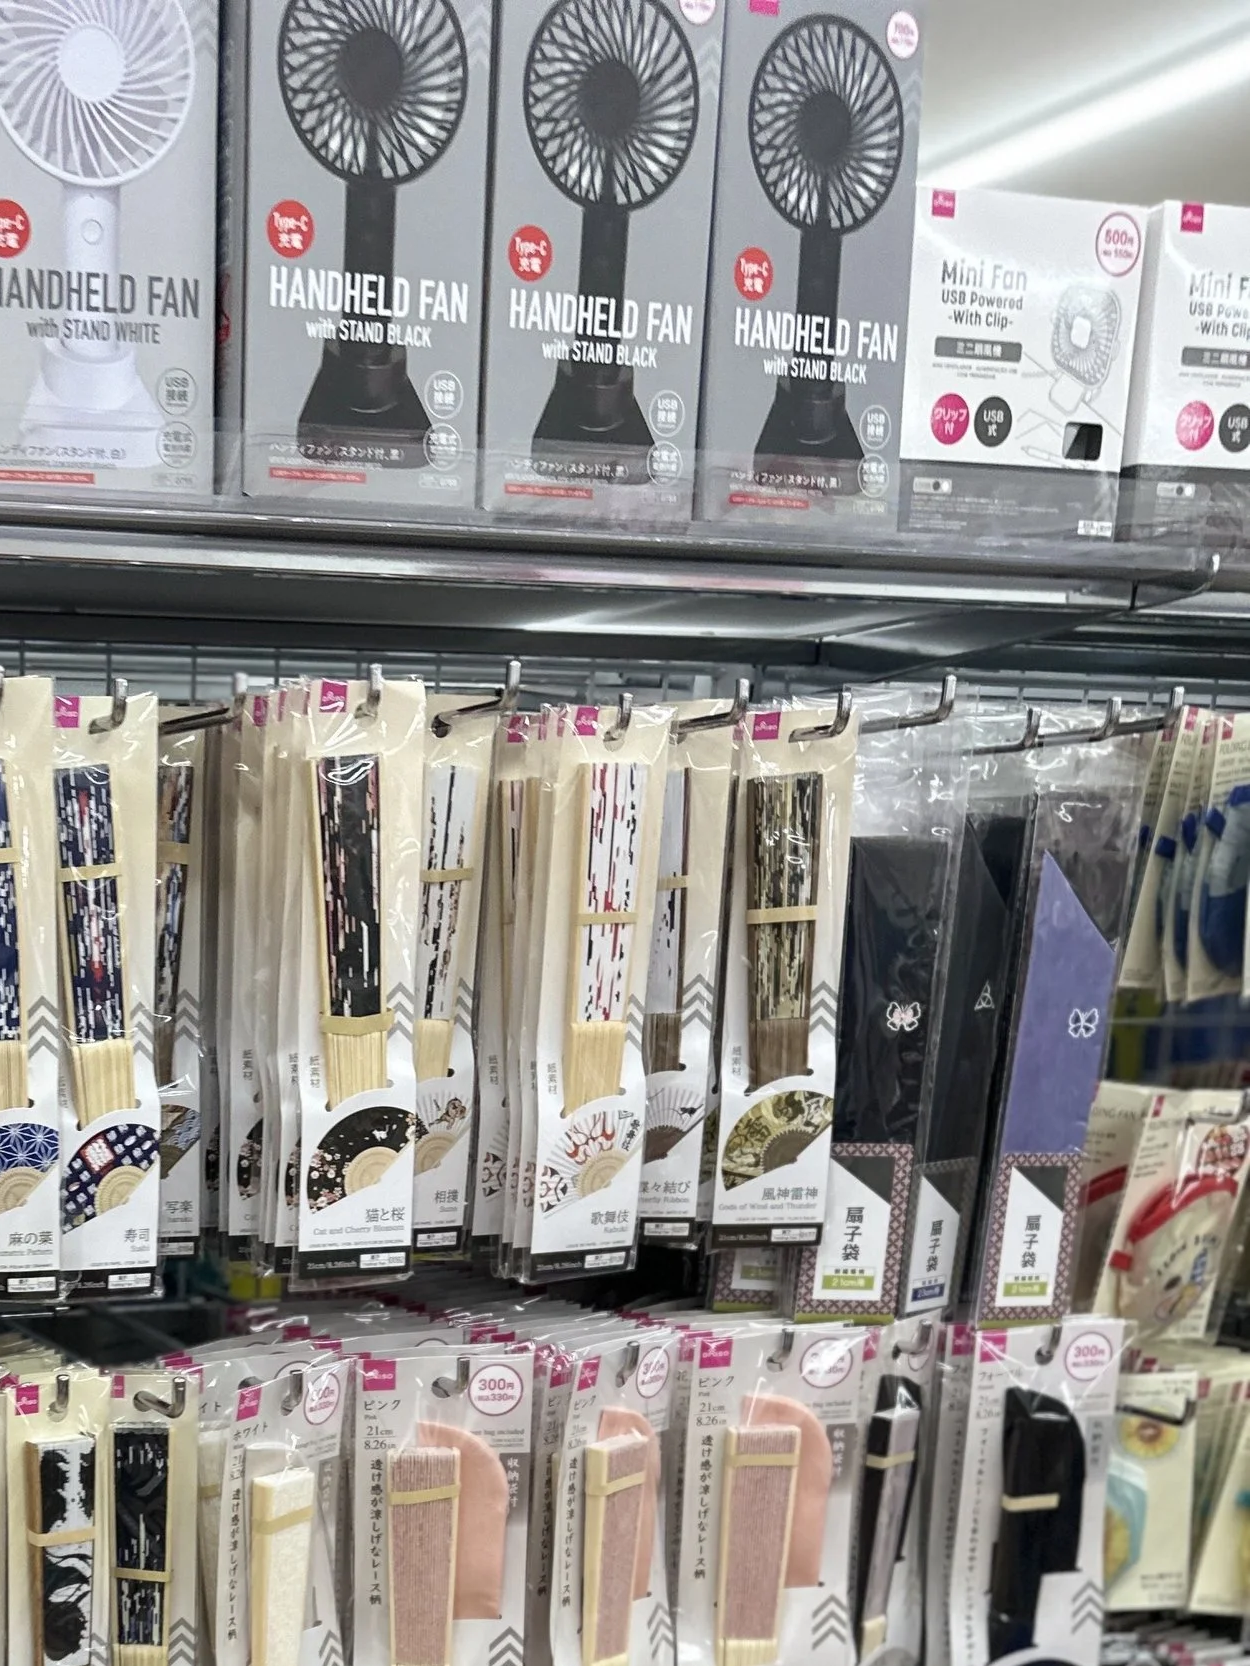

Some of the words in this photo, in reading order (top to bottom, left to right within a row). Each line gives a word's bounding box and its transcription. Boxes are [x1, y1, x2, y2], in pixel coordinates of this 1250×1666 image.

[1104, 229, 1135, 248] 500円
[941, 259, 985, 289] Mini
[991, 264, 1028, 292] Fan
[270, 265, 411, 319] HANDHELD
[419, 279, 469, 324] FAN
[1190, 272, 1232, 299] Mini
[146, 275, 201, 319] FAN
[941, 290, 967, 304] USB
[970, 291, 1024, 311] Powered
[510, 289, 639, 341] HANDHELD
[646, 302, 693, 346] FAN
[1190, 301, 1214, 317] USB
[1219, 304, 1250, 319] Powe
[948, 310, 982, 327] -With
[985, 311, 1014, 331] Clip-
[26, 318, 58, 340] with
[62, 319, 111, 344] STAND
[114, 321, 162, 346] WHITE
[306, 318, 337, 341] with
[339, 320, 385, 347] STAND
[387, 323, 432, 349] BLACK
[734, 306, 851, 360] HANDHELD
[857, 319, 899, 364] FAN
[542, 340, 570, 361] with
[572, 342, 613, 366] STAND
[616, 344, 658, 370] BLACK
[763, 357, 788, 379] with
[790, 359, 829, 383] STAND
[830, 361, 868, 386] BLACK
[933, 408, 968, 423] クリップ
[983, 409, 1005, 424] USB
[1180, 413, 1213, 430] クリップ
[1226, 417, 1248, 431] USB
[943, 422, 956, 437] 付
[987, 422, 999, 438] 式
[761, 1185, 819, 1202] 風神雷神
[366, 1206, 406, 1223] 猫と桜
[718, 1203, 737, 1211] Gods
[749, 1202, 768, 1211] Wind
[786, 1202, 818, 1211] Thunder
[590, 1210, 630, 1227] 歌舞伎
[8, 1231, 54, 1247] 麻の葉
[124, 1228, 151, 1243] 寿司
[841, 1206, 866, 1263] 扇子袋
[1021, 1214, 1042, 1269] 扇子袋
[926, 1219, 945, 1274] 扇子袋
[1073, 1345, 1106, 1358] 300円
[478, 1378, 515, 1392] 300円
[698, 1375, 735, 1388] ピンク
[364, 1400, 401, 1412] ピンク
[699, 1402, 726, 1413] 21cm
[366, 1426, 394, 1437] 21cm
[694, 1435, 714, 1580] 透け感が涼しげなレース柄
[368, 1459, 384, 1606] 透け感が涼しげなレース柄
